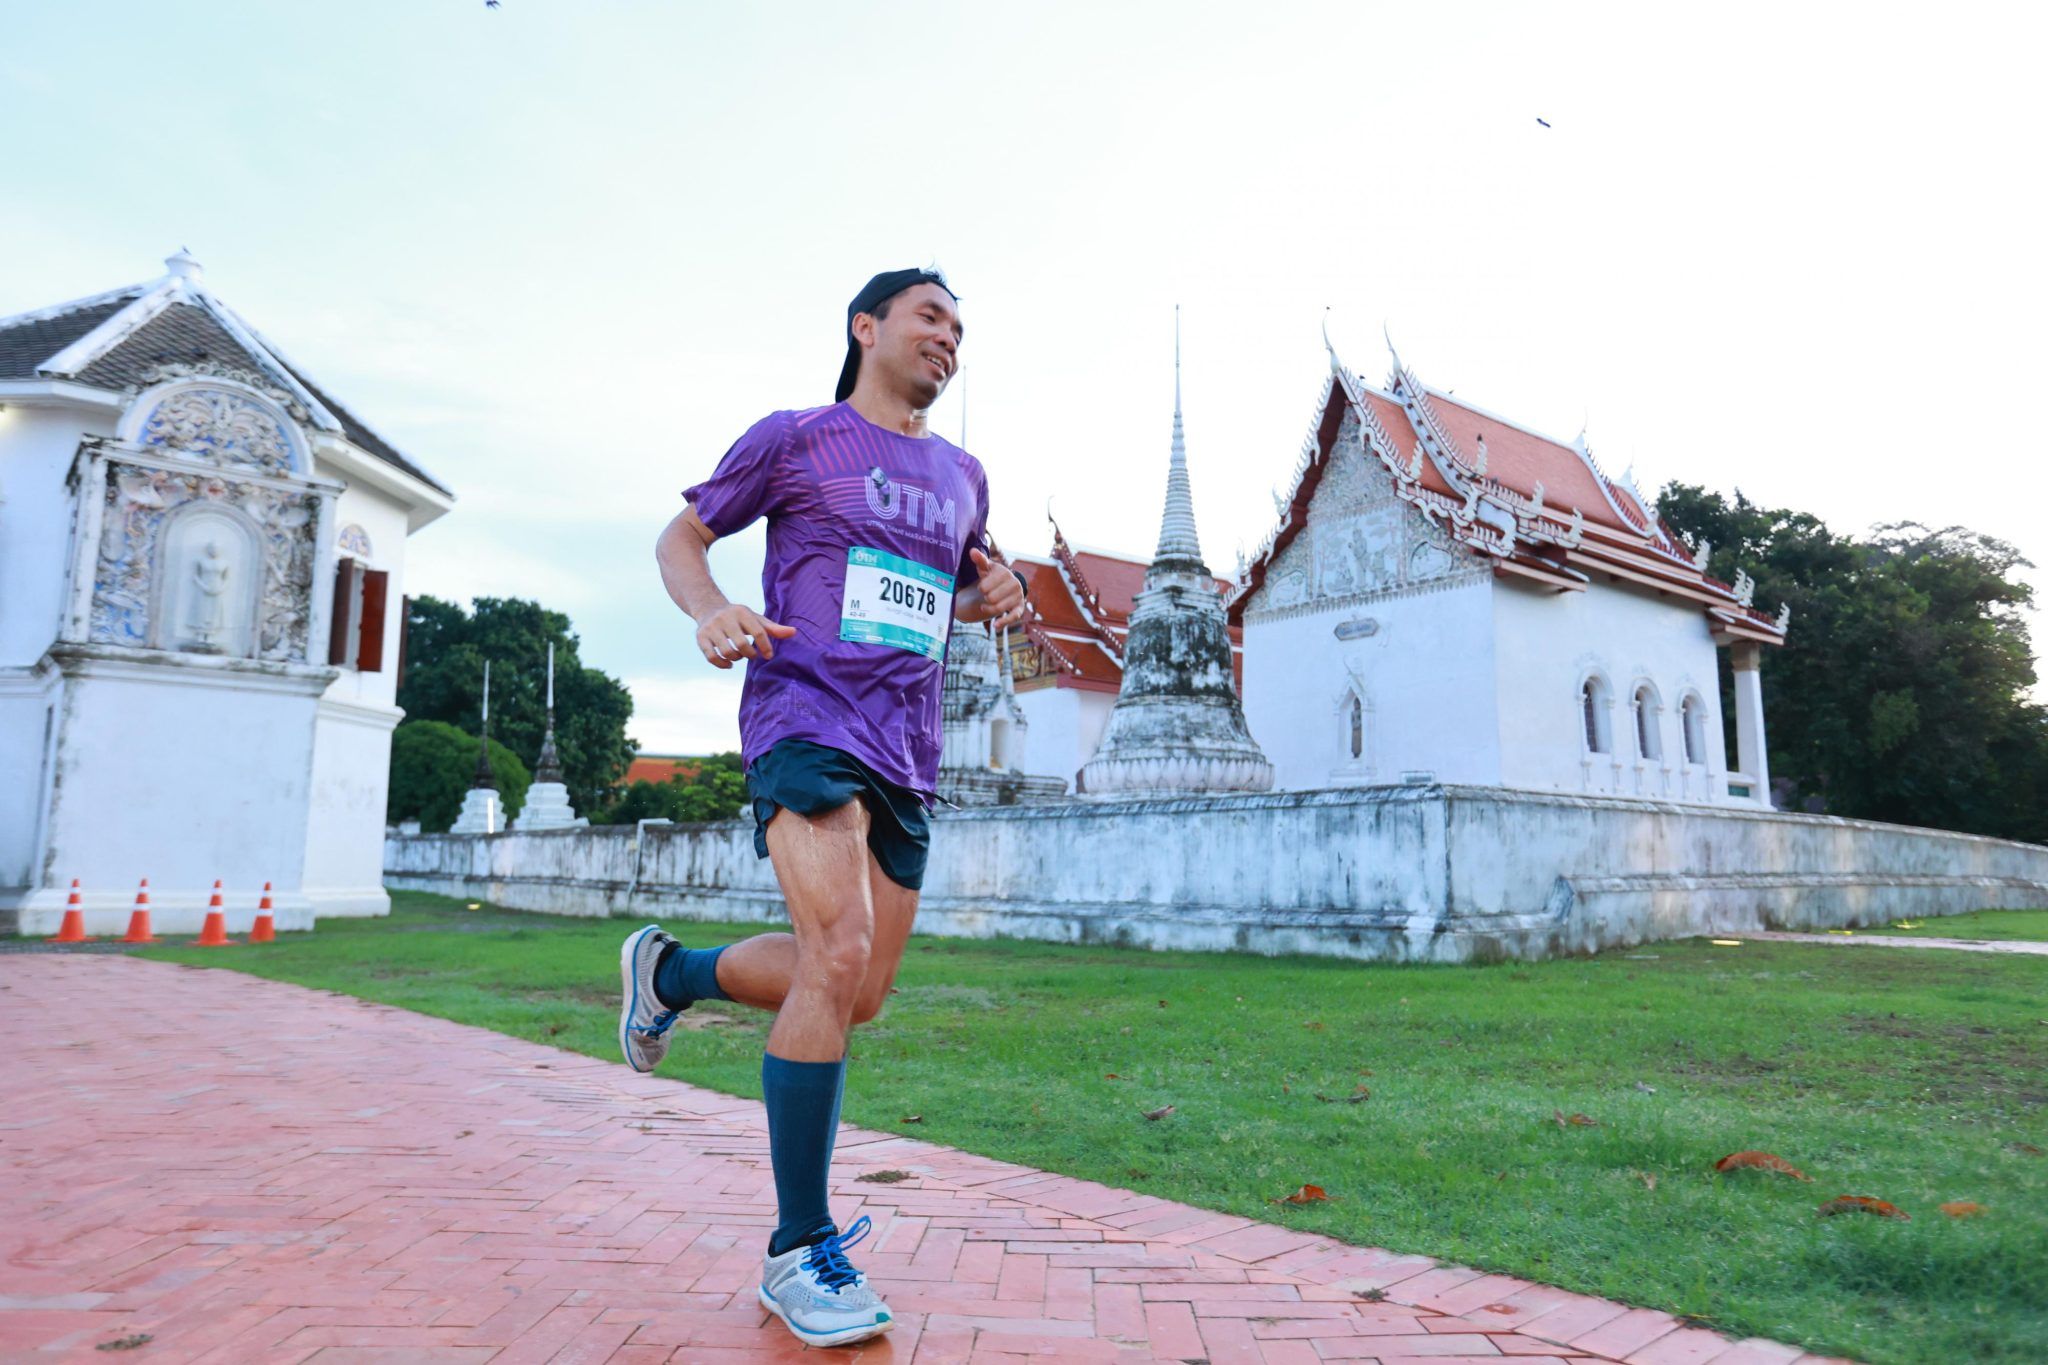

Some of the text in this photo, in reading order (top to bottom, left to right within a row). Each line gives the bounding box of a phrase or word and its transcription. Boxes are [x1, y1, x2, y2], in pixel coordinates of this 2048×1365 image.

[864, 475, 956, 538] UTM
[904, 531, 938, 545] MARATHON
[850, 599, 860, 609] M
[879, 576, 936, 616] 20678
